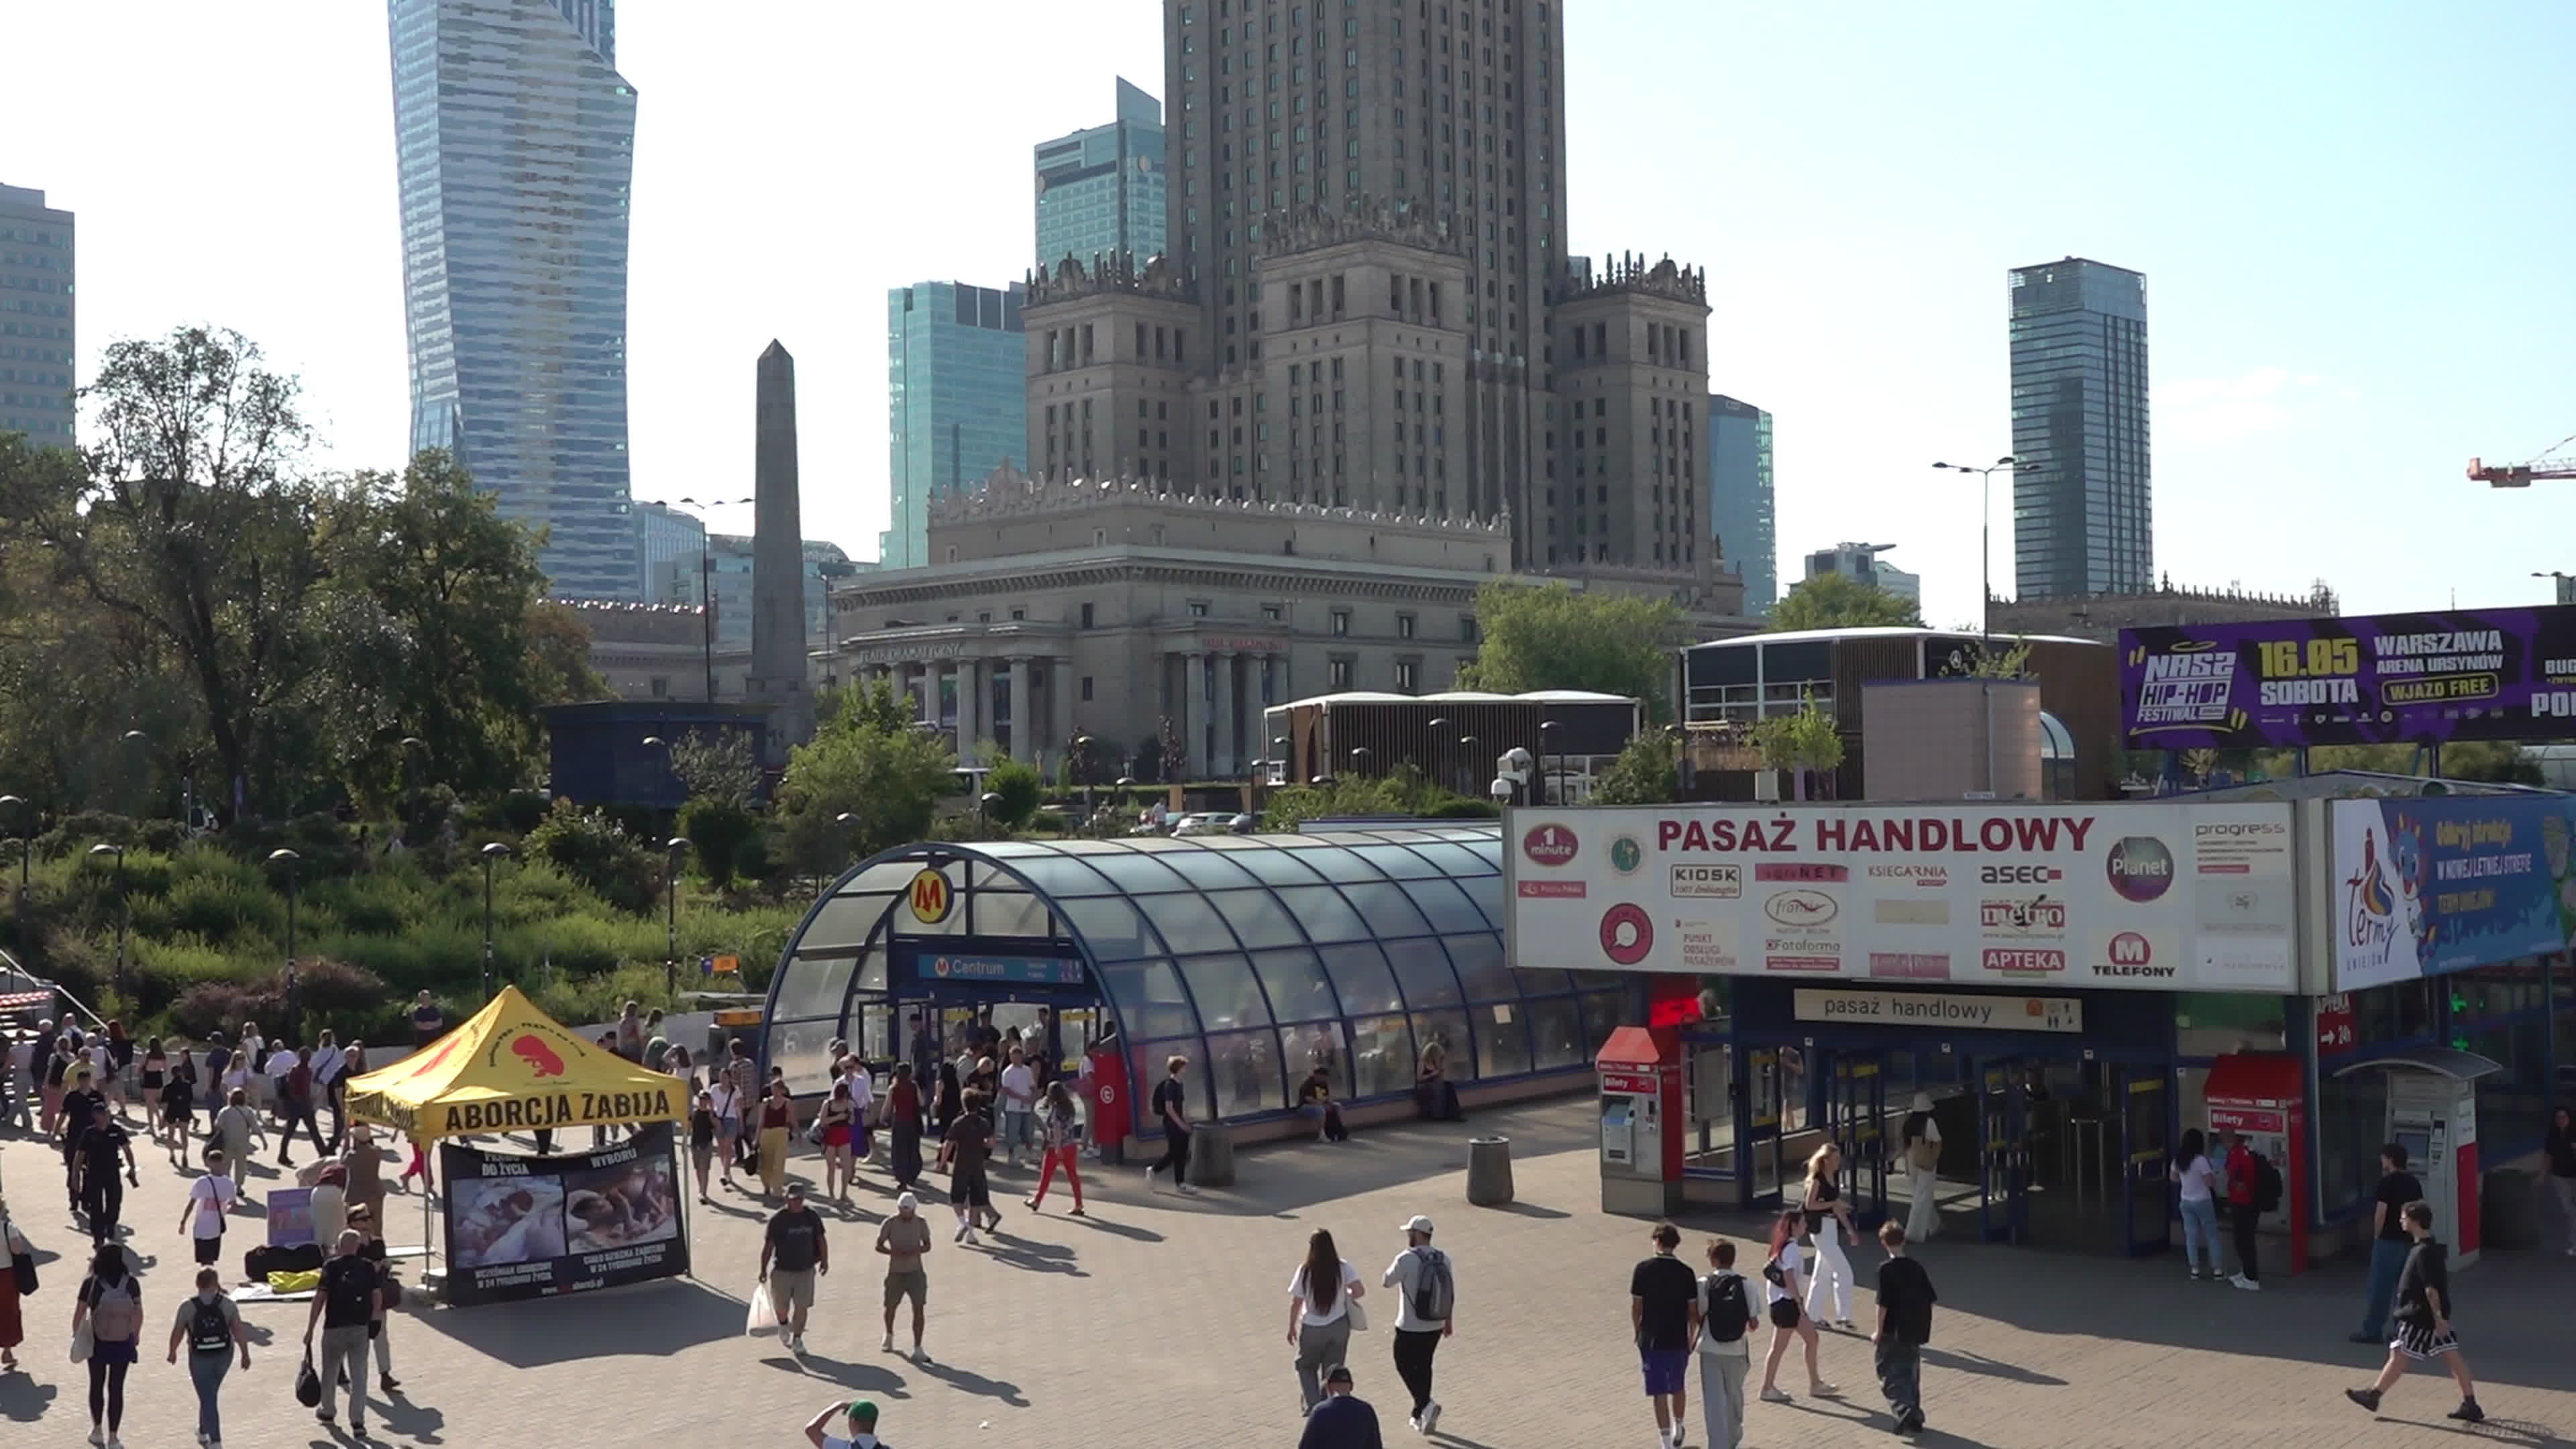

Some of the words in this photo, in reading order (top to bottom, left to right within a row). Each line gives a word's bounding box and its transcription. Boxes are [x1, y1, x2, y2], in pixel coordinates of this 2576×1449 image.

[2373, 629, 2504, 657] WARSZAWA
[2145, 652, 2237, 682] NASZ
[2258, 637, 2359, 678] 16.05
[2375, 658, 2425, 674] ARENA
[2427, 653, 2504, 673] URSYNÓW
[2140, 680, 2232, 708] HIP-HOP
[2259, 678, 2360, 706] SOBOTA
[2390, 681, 2445, 702] WJAZD
[2447, 676, 2490, 697] FREE
[2137, 706, 2198, 722] FESTIWAL
[1544, 827, 1555, 845] 1
[1658, 811, 1797, 852] PASAŻ
[1816, 816, 2096, 853] HANDLOWY
[2195, 823, 2286, 837] progress
[1530, 843, 1572, 855] minute
[1675, 868, 1737, 881] KIOSK
[915, 879, 942, 913] M
[2346, 867, 2400, 965] termy
[1776, 939, 1841, 951] Fotoforma
[2114, 941, 2144, 961] M
[952, 959, 1004, 975] Centrum
[1986, 951, 2061, 969] APTEKA
[2092, 965, 2176, 977] TELEFONY
[1824, 996, 1880, 1016] pasaż
[1892, 998, 1992, 1024] handlowy
[1605, 1075, 1628, 1089] Bilety
[445, 1093, 573, 1132] ABORCJA
[581, 1089, 670, 1120] ZABIJA
[2212, 1113, 2243, 1126] Bilety
[482, 1163, 497, 1176] DO
[499, 1161, 530, 1175] ŻYCIA
[590, 1148, 637, 1169] WYBORU
